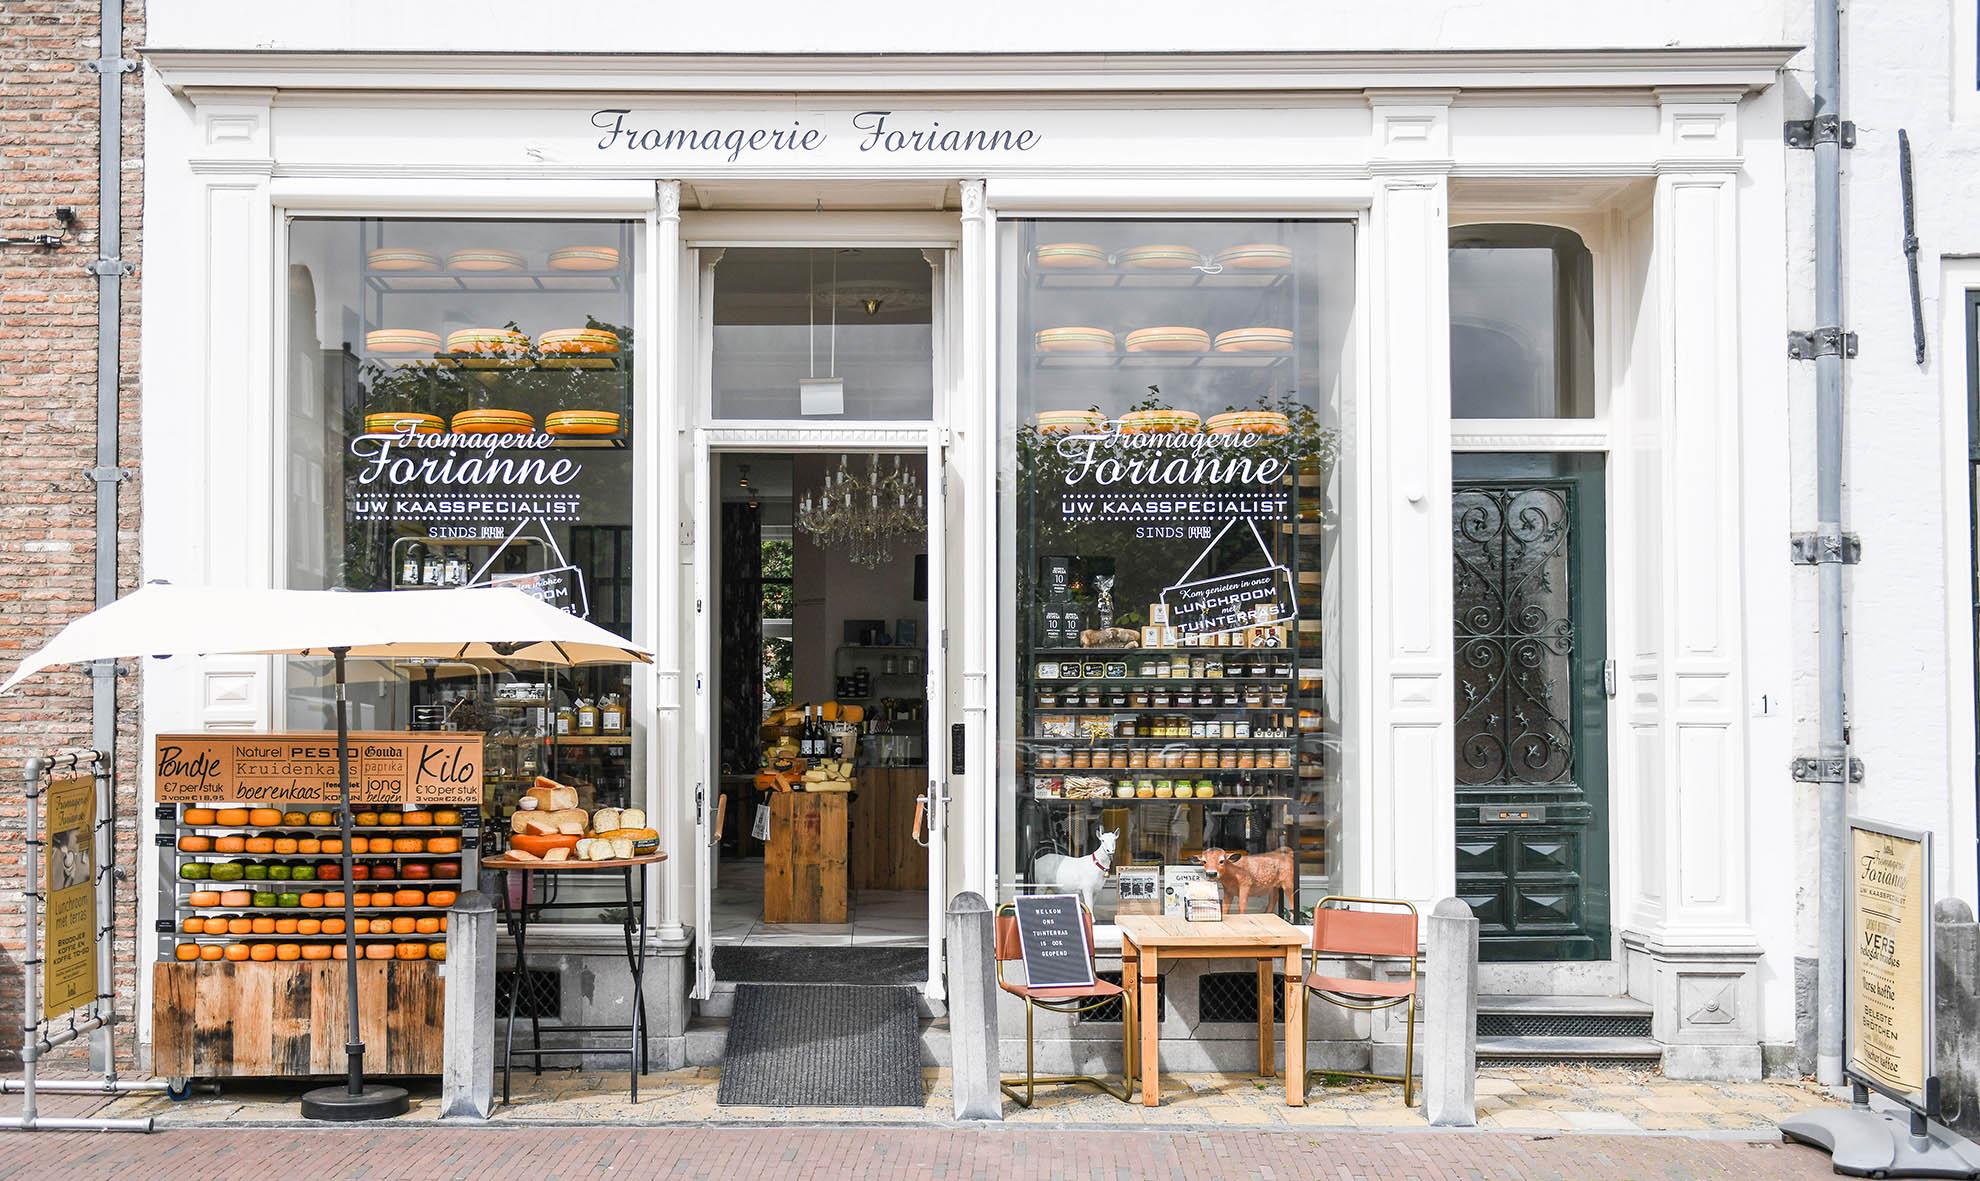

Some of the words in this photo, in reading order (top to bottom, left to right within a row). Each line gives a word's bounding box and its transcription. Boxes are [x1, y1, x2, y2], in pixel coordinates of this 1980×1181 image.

[591, 109, 827, 162] Fromagerie
[852, 111, 1042, 152] Forianne
[394, 419, 555, 458] Fromagerie
[1100, 419, 1262, 458] Fromagerie
[351, 434, 582, 485] Forianne
[1057, 435, 1288, 485] Forianne
[356, 501, 388, 514] UW
[397, 501, 580, 514] KAASSPECIALIST
[1062, 501, 1095, 513] UW
[1103, 500, 1288, 513] KAASSPECIALIST
[429, 526, 476, 538] SINDS
[1136, 527, 1184, 538] SINDS
[1055, 574, 1064, 583] 10
[1180, 588, 1204, 600] Kom
[1204, 582, 1239, 598] genieten
[1240, 580, 1251, 588] in
[1251, 576, 1272, 587] onze
[1174, 587, 1277, 615] LUNCHROOM
[1221, 604, 1237, 614] met
[1048, 620, 1058, 629] 10
[1067, 620, 1076, 629] 10
[1178, 603, 1286, 633] TUINTERRAS!
[1761, 693, 1767, 714] 1
[236, 747, 282, 758] Naturel
[291, 748, 358, 758] PESTO
[364, 746, 402, 758] Gouda
[158, 746, 222, 791] Pondje
[237, 763, 357, 775] Kruidenkas
[365, 761, 402, 774] paprika
[416, 744, 474, 784] Kilo
[164, 782, 177, 792] €7
[180, 784, 199, 794] per
[203, 783, 223, 792] stuk
[237, 779, 321, 800] boerenkaas
[365, 777, 401, 794] jong
[438, 787, 456, 796] per
[457, 785, 477, 794] stuk
[367, 791, 401, 802] belegen
[1865, 931, 1895, 954] VERS
